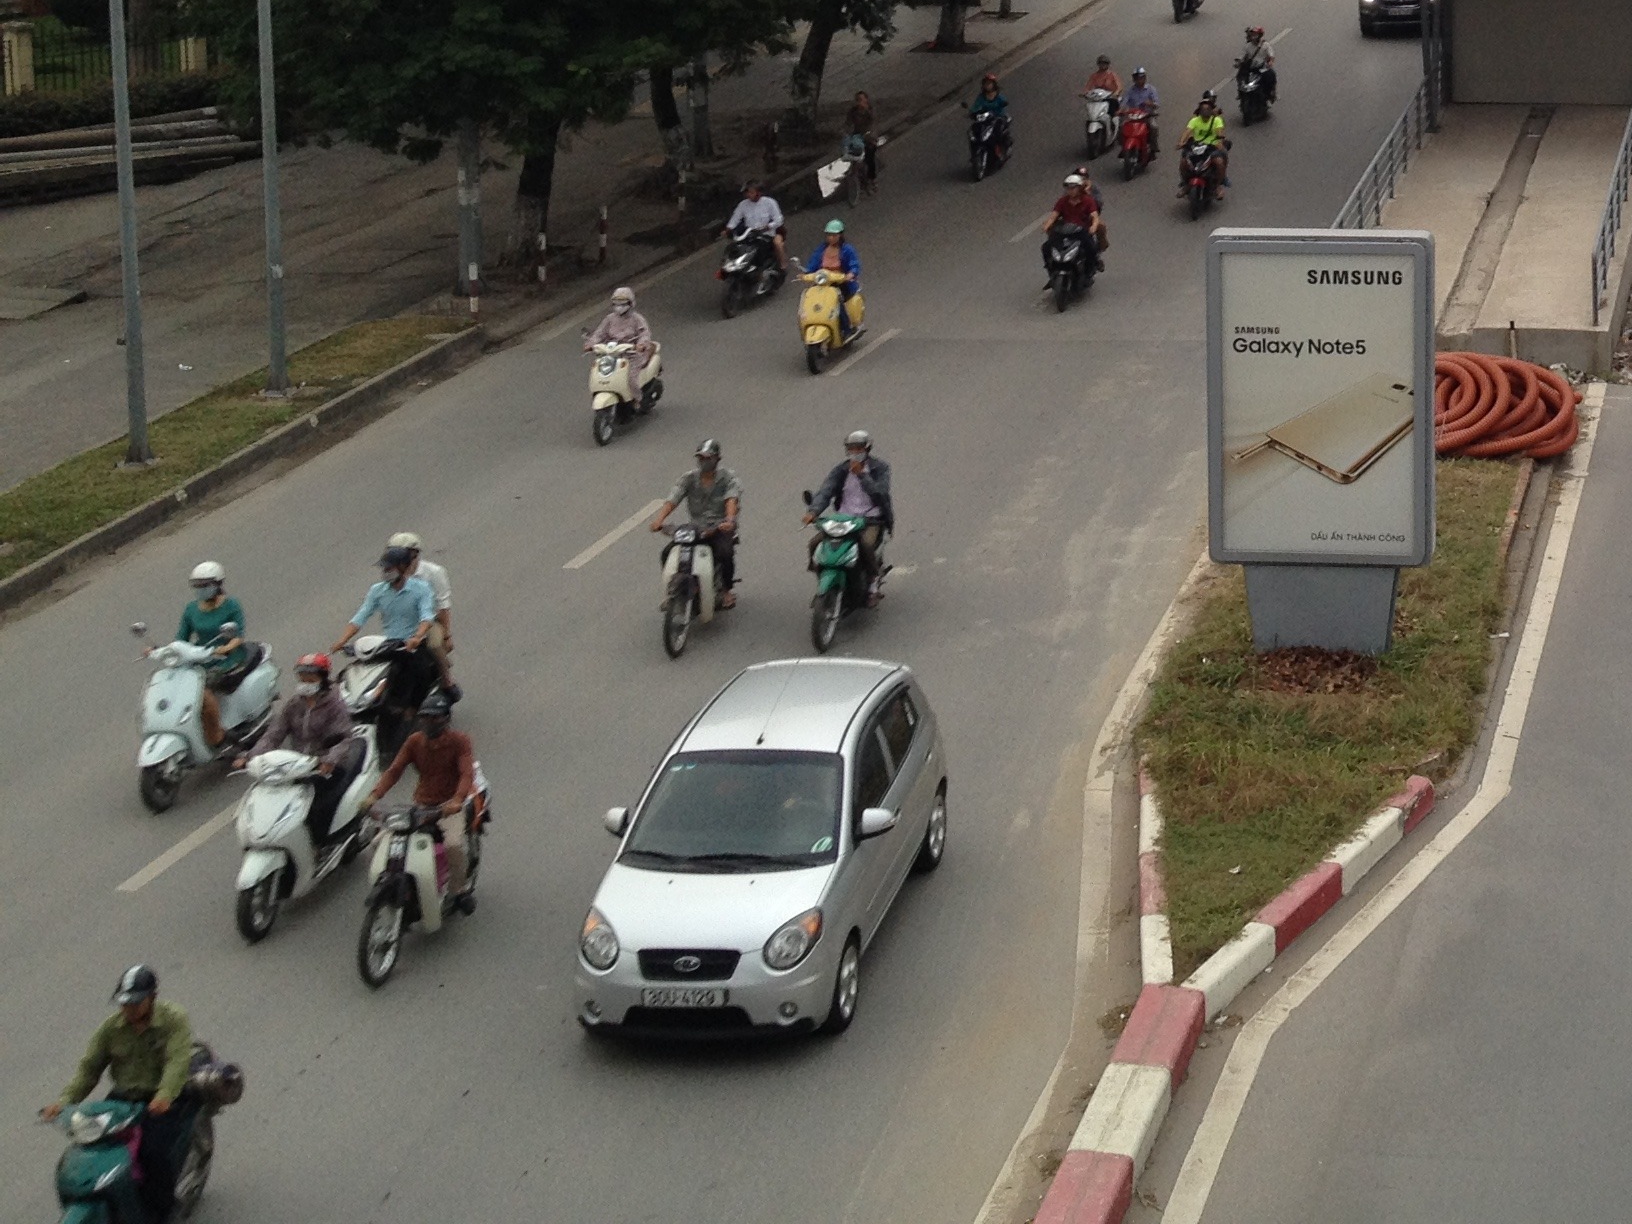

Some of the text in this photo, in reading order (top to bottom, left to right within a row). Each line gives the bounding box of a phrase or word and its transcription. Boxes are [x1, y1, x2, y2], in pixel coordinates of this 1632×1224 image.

[1307, 269, 1403, 286] SAMSUNG
[1234, 326, 1280, 335] SAMSUNG
[1232, 337, 1366, 358] Galaxy Note5
[1311, 531, 1405, 542] DẤU ẤN THÀNH CÔNG
